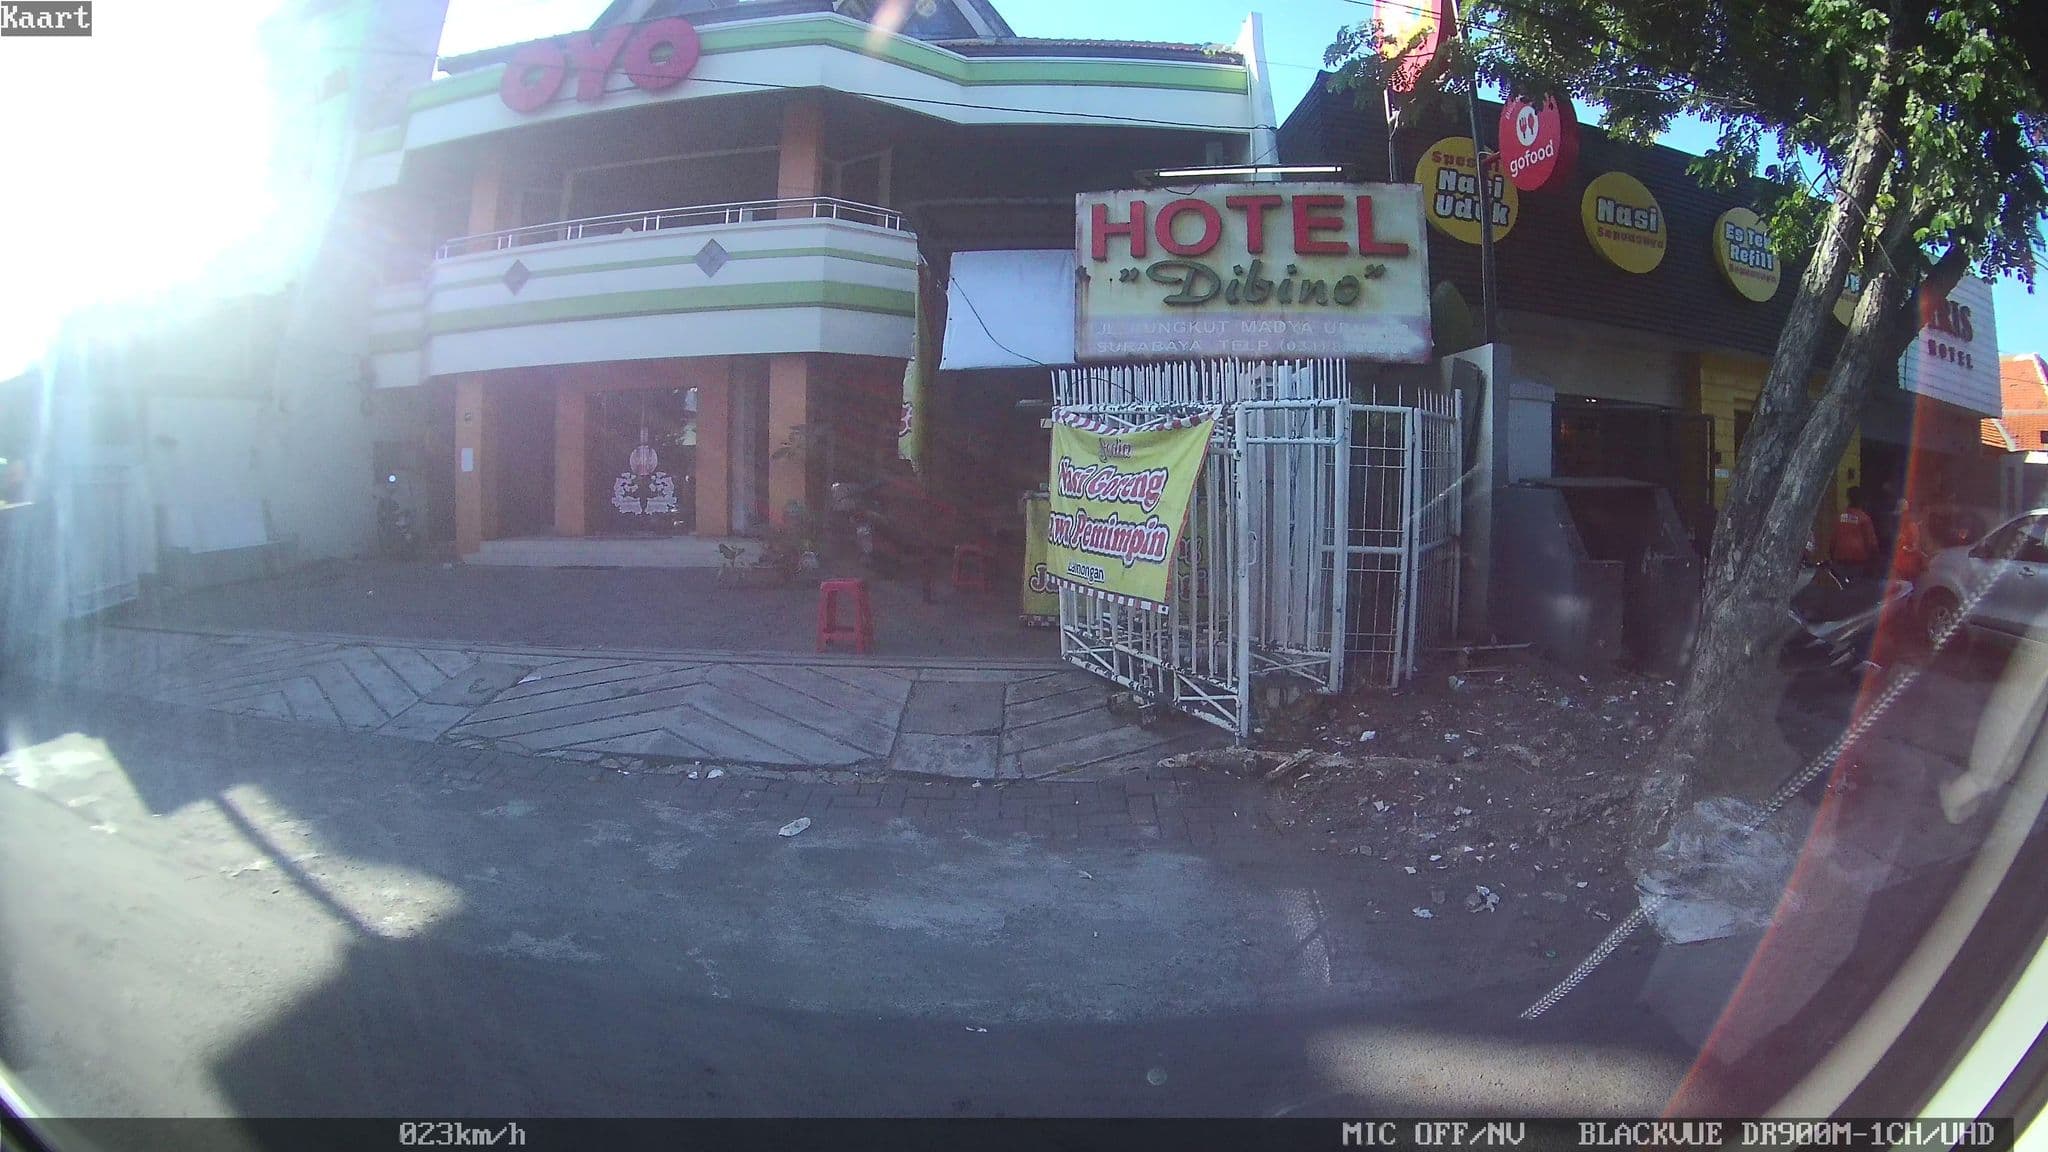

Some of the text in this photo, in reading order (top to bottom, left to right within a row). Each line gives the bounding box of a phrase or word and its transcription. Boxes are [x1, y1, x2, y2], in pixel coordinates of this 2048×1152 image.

[500, 16, 702, 113] OYO
[1510, 139, 1554, 178] gofood
[1437, 169, 1504, 200] Nai
[1091, 194, 1409, 262] HOTEL
[1596, 197, 1658, 232] Nasi
[1725, 222, 1744, 242] Es
[1730, 242, 1773, 270] Refill
[1241, 320, 1313, 335] MADYA
[1086, 465, 1168, 514] Goreng
[1071, 508, 1169, 568] Pemimpin
